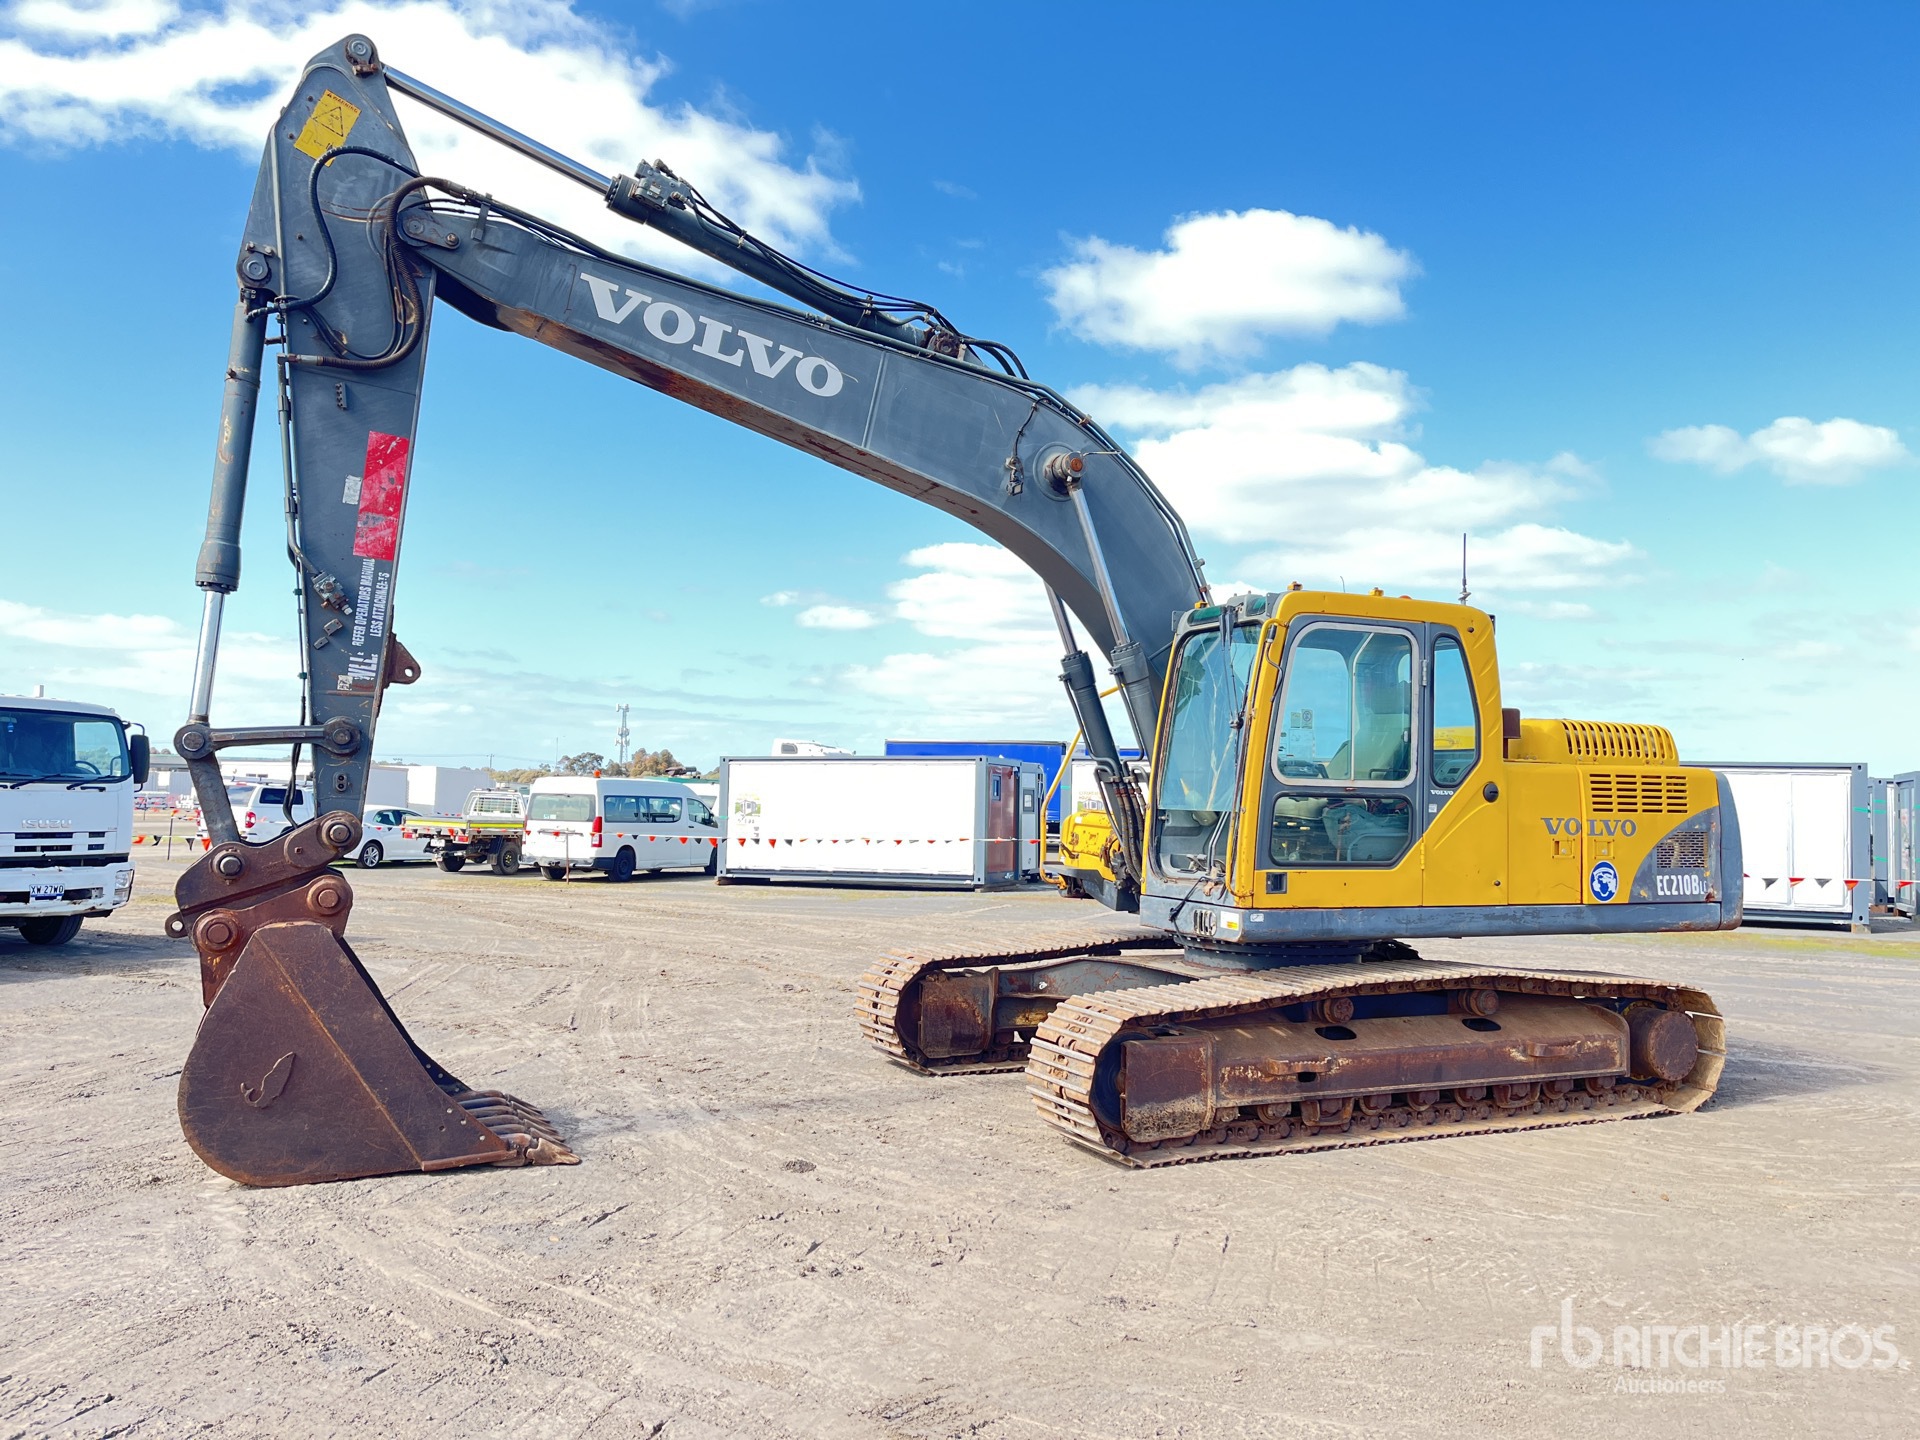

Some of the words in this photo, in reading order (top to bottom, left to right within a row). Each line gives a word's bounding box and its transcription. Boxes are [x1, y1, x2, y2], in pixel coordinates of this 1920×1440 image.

[580, 272, 844, 397] VOLVO
[360, 559, 375, 586] MANUAL
[355, 586, 371, 625] OPERATORS
[352, 625, 366, 646] REFER
[370, 620, 383, 637] LESS
[22, 819, 72, 829] ISUZU
[1540, 817, 1637, 838] VOLVO
[31, 885, 42, 894] XW
